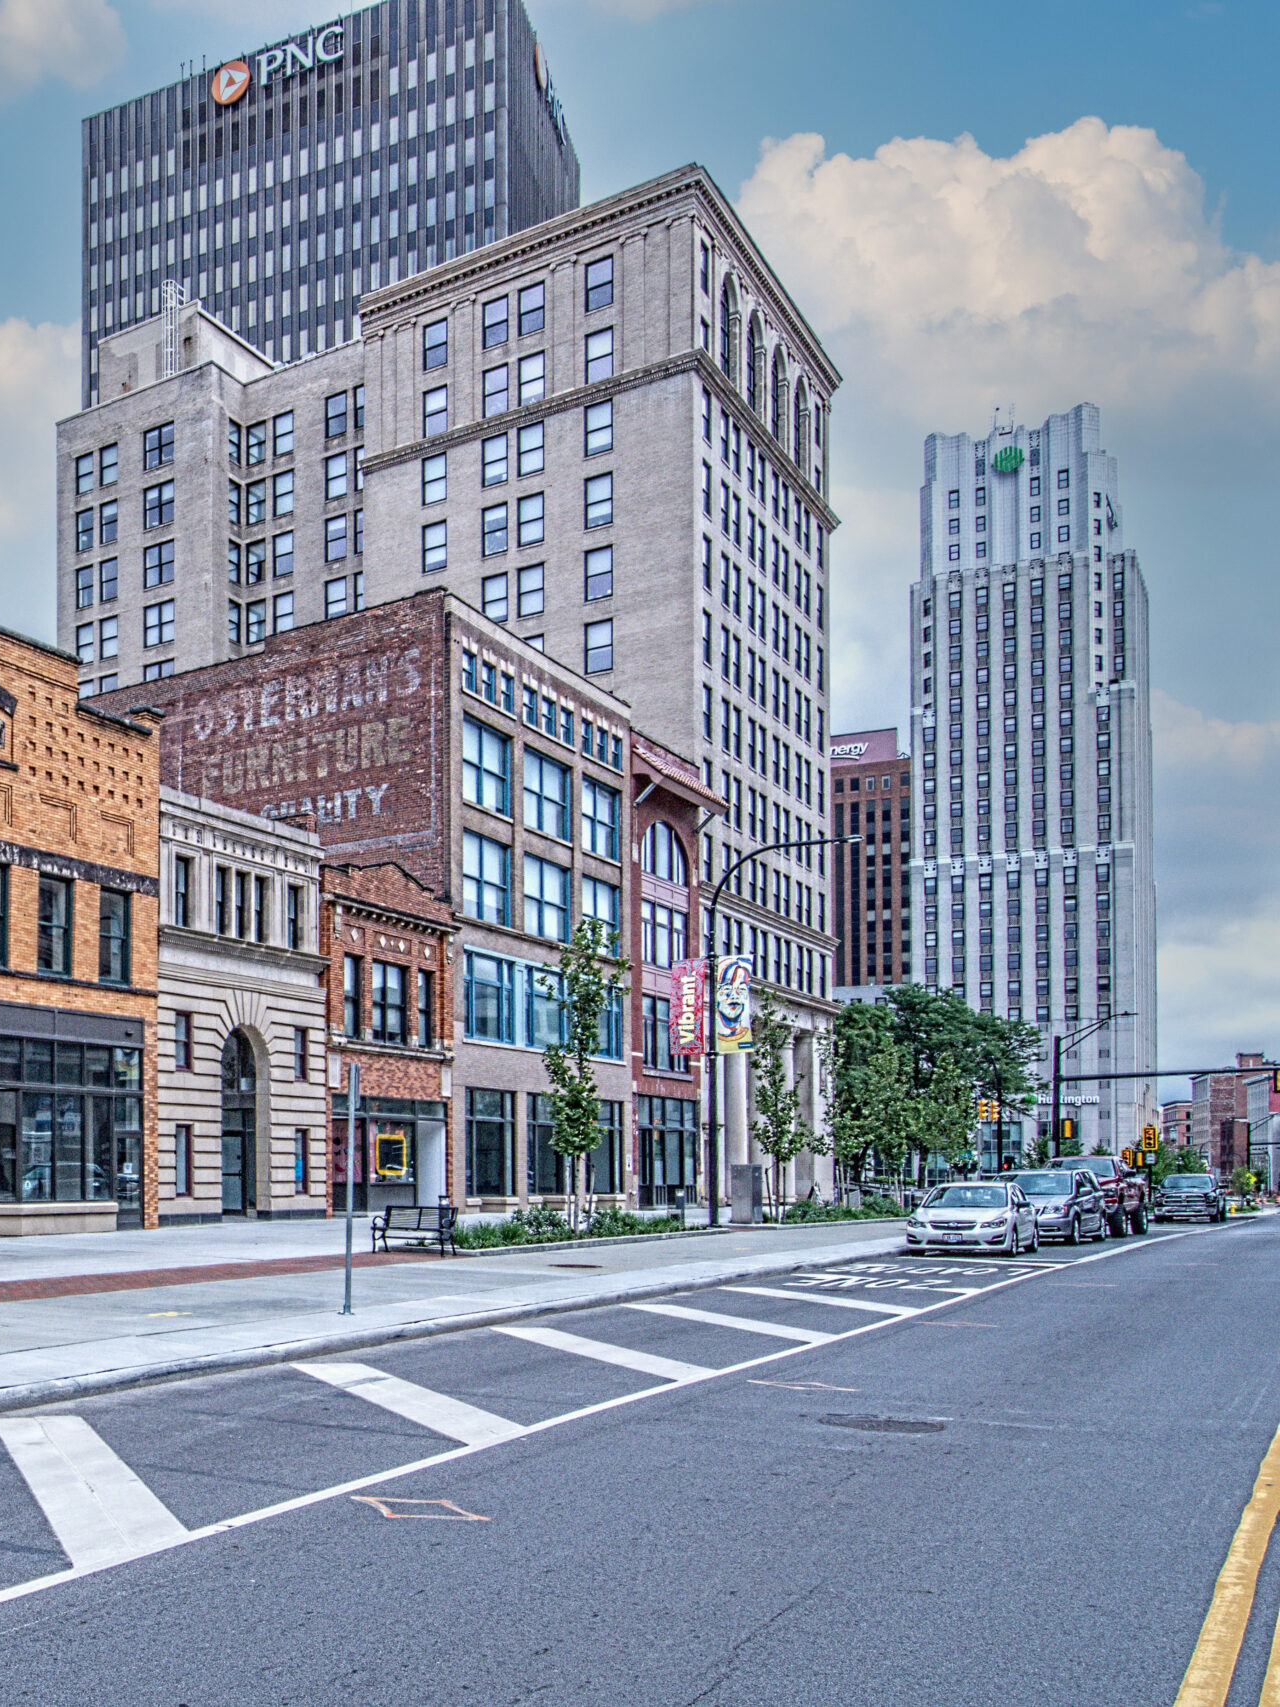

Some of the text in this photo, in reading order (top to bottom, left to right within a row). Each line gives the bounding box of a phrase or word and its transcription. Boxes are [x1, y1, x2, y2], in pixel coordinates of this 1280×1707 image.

[256, 25, 344, 87] PNC
[830, 742, 870, 756] nergy
[677, 970, 698, 1045] Vibrant.
[1038, 1093, 1100, 1107] Hutington
